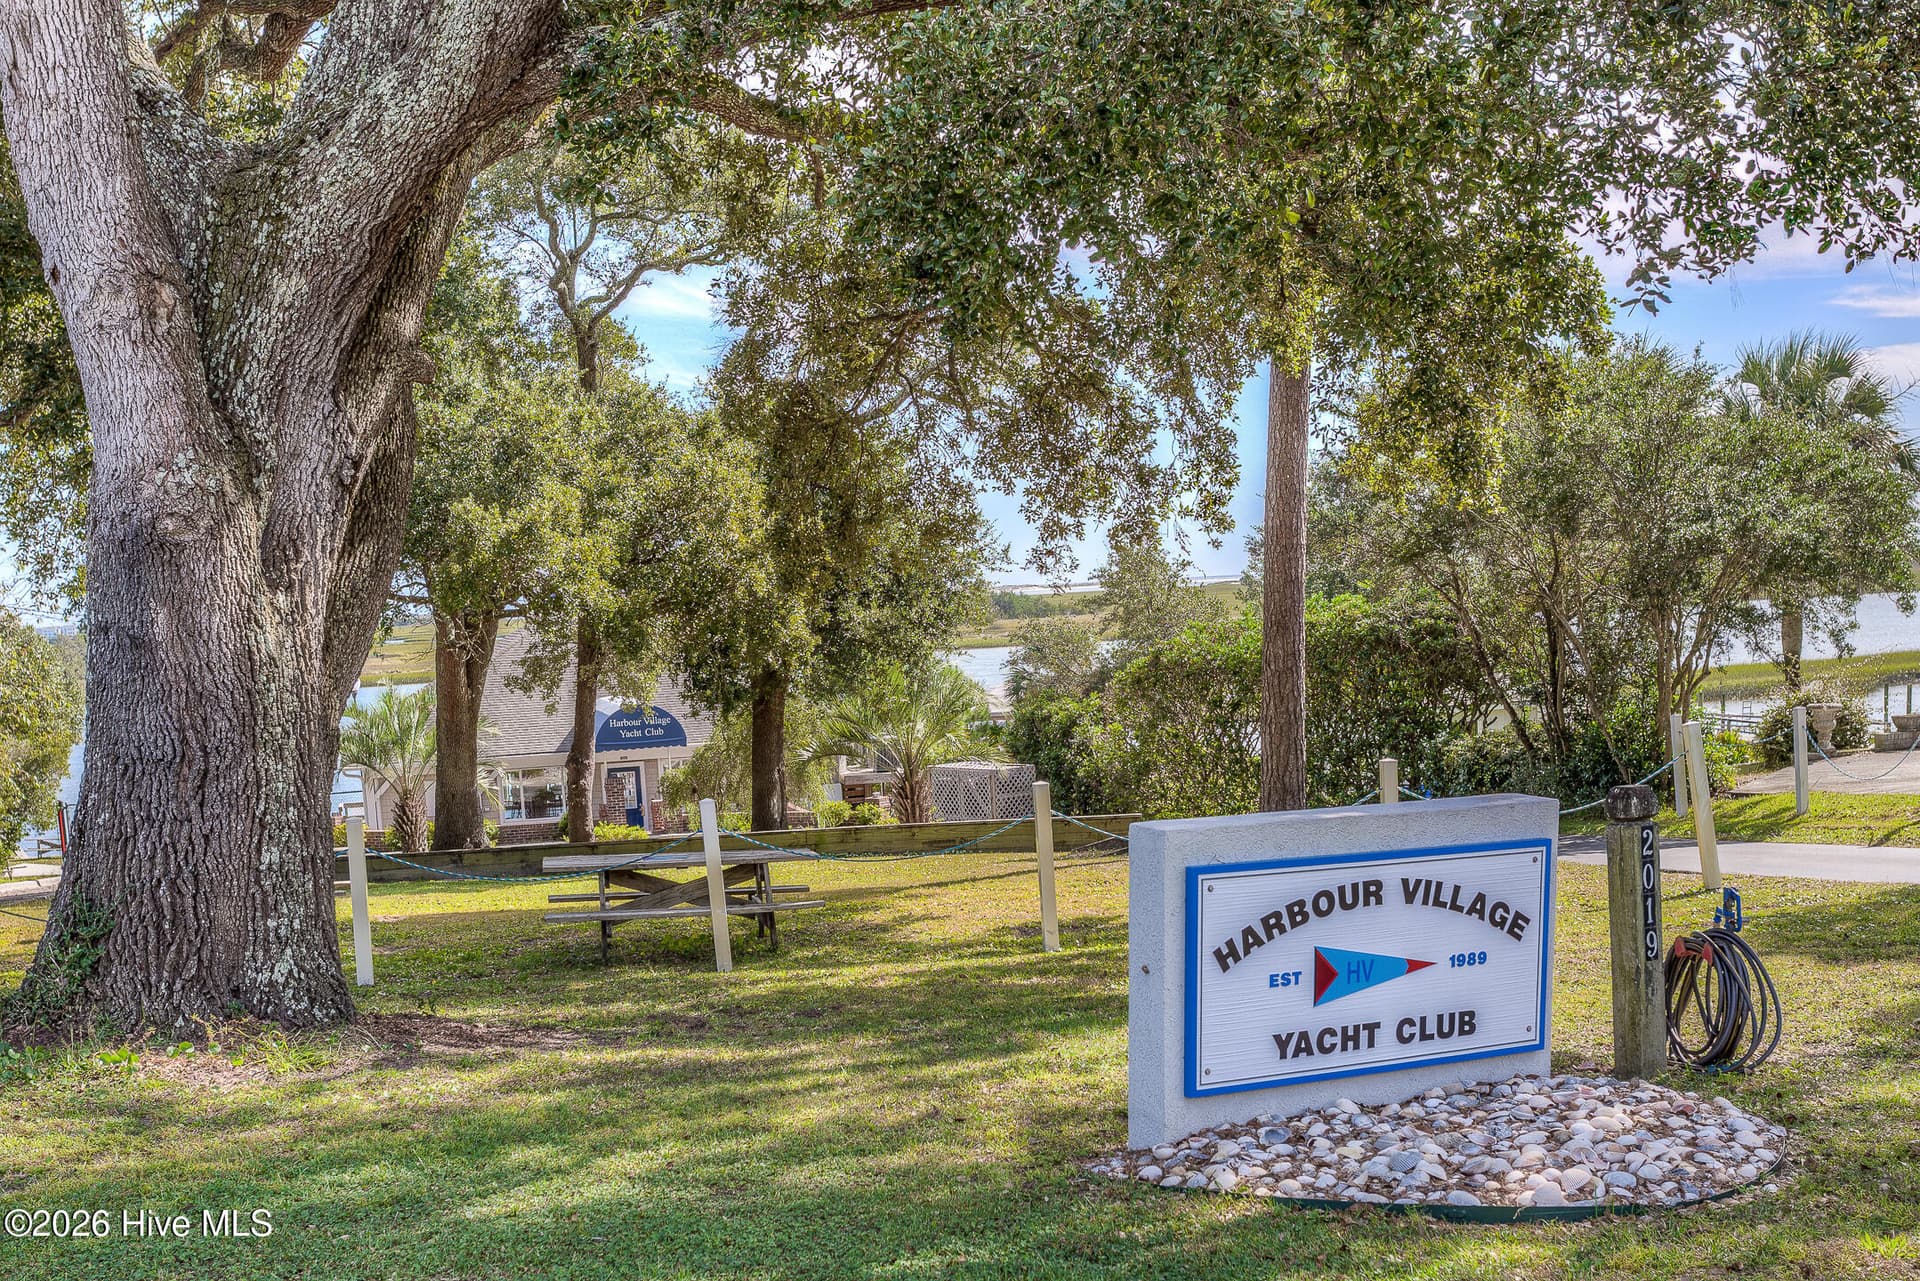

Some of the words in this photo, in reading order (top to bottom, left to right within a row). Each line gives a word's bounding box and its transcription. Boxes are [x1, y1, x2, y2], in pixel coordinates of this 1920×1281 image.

[609, 718, 641, 728] Harbour
[643, 715, 671, 726] Village
[620, 729, 642, 738] Yacht
[645, 728, 664, 736] Club
[1641, 829, 1659, 958] 2019
[1212, 879, 1384, 974] HARBOUR
[1400, 877, 1531, 943] VILLAGE
[1449, 951, 1487, 968] 1989
[1269, 971, 1302, 988] EST
[1347, 959, 1375, 985] HV
[1272, 1021, 1381, 1060] YACHT
[1395, 1010, 1477, 1044] CLUB
